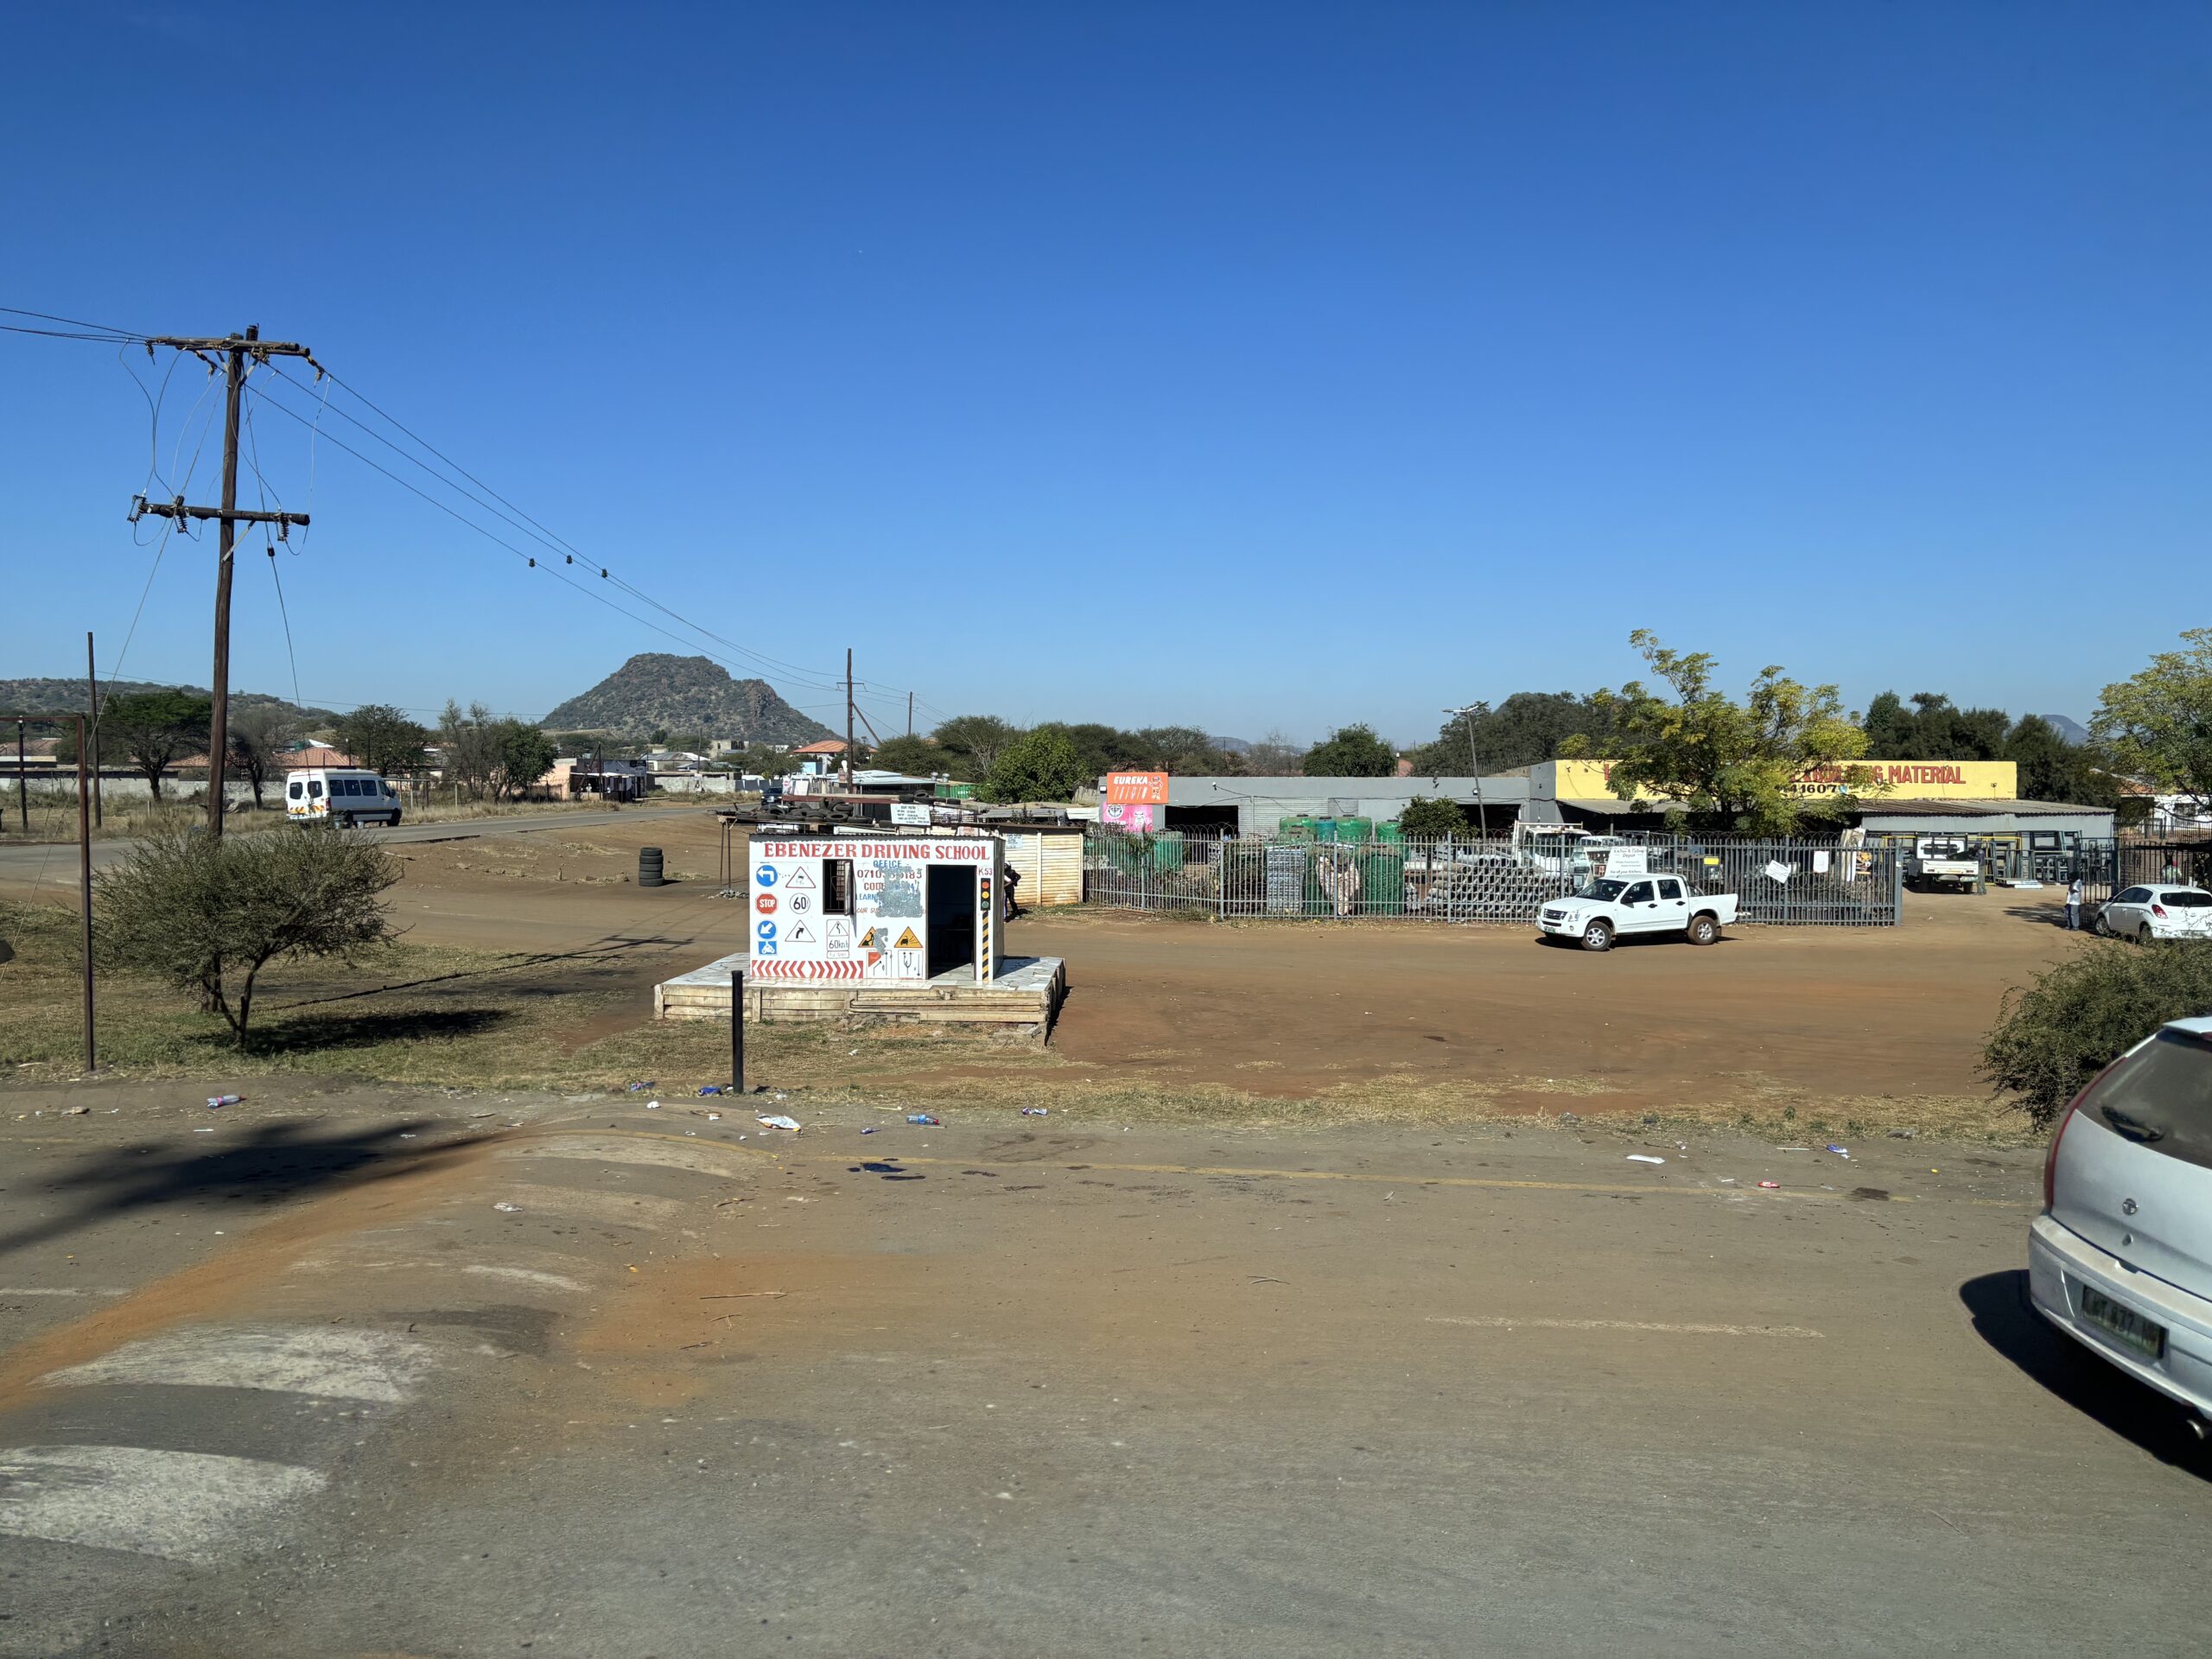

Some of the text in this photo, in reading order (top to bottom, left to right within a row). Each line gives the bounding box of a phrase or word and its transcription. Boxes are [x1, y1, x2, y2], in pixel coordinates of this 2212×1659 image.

[1113, 776, 1148, 785] EUREKA
[1889, 765, 1966, 785] MATERIAL
[1775, 784, 1837, 794] 41607
[765, 842, 990, 861] EBENEZER DRIVING SCHOOL
[759, 896, 806, 910] STOP 60
